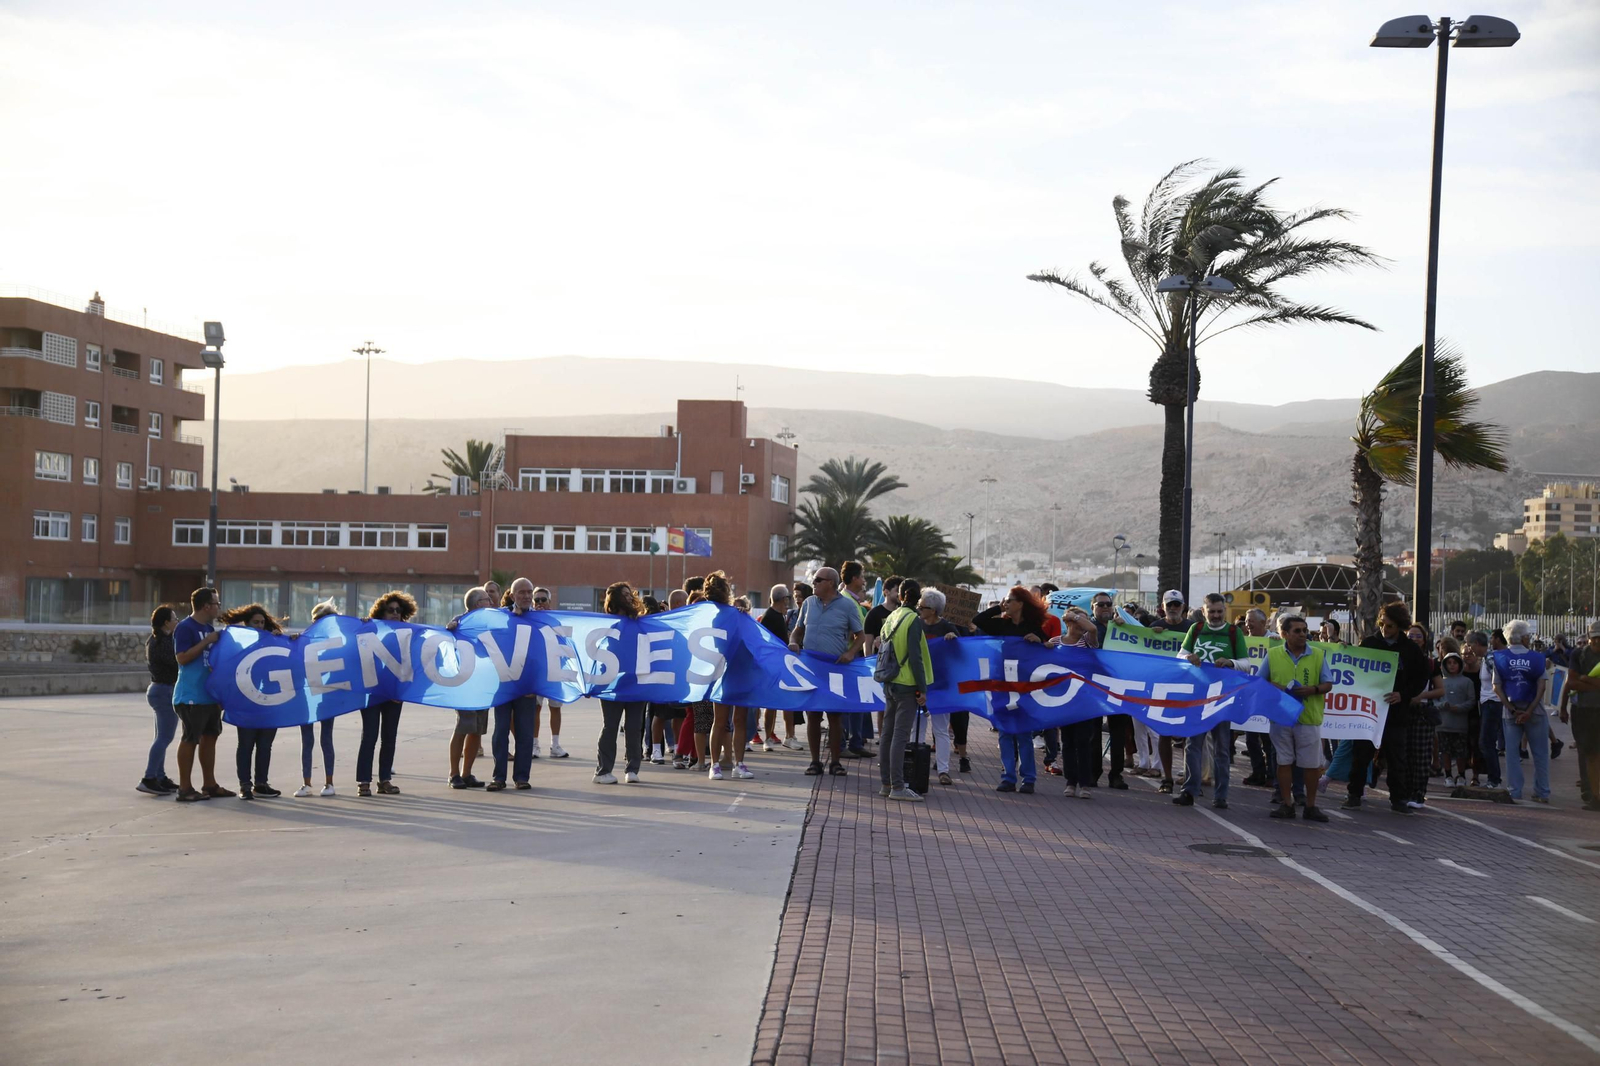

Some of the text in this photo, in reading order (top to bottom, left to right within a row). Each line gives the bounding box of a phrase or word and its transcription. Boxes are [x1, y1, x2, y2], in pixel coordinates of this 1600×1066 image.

[1110, 627, 1139, 645] Los
[235, 624, 728, 706] GENOVESES
[978, 658, 1235, 724] HOTEL
[1331, 652, 1392, 674] parque
[1324, 692, 1379, 718] HOTEL
